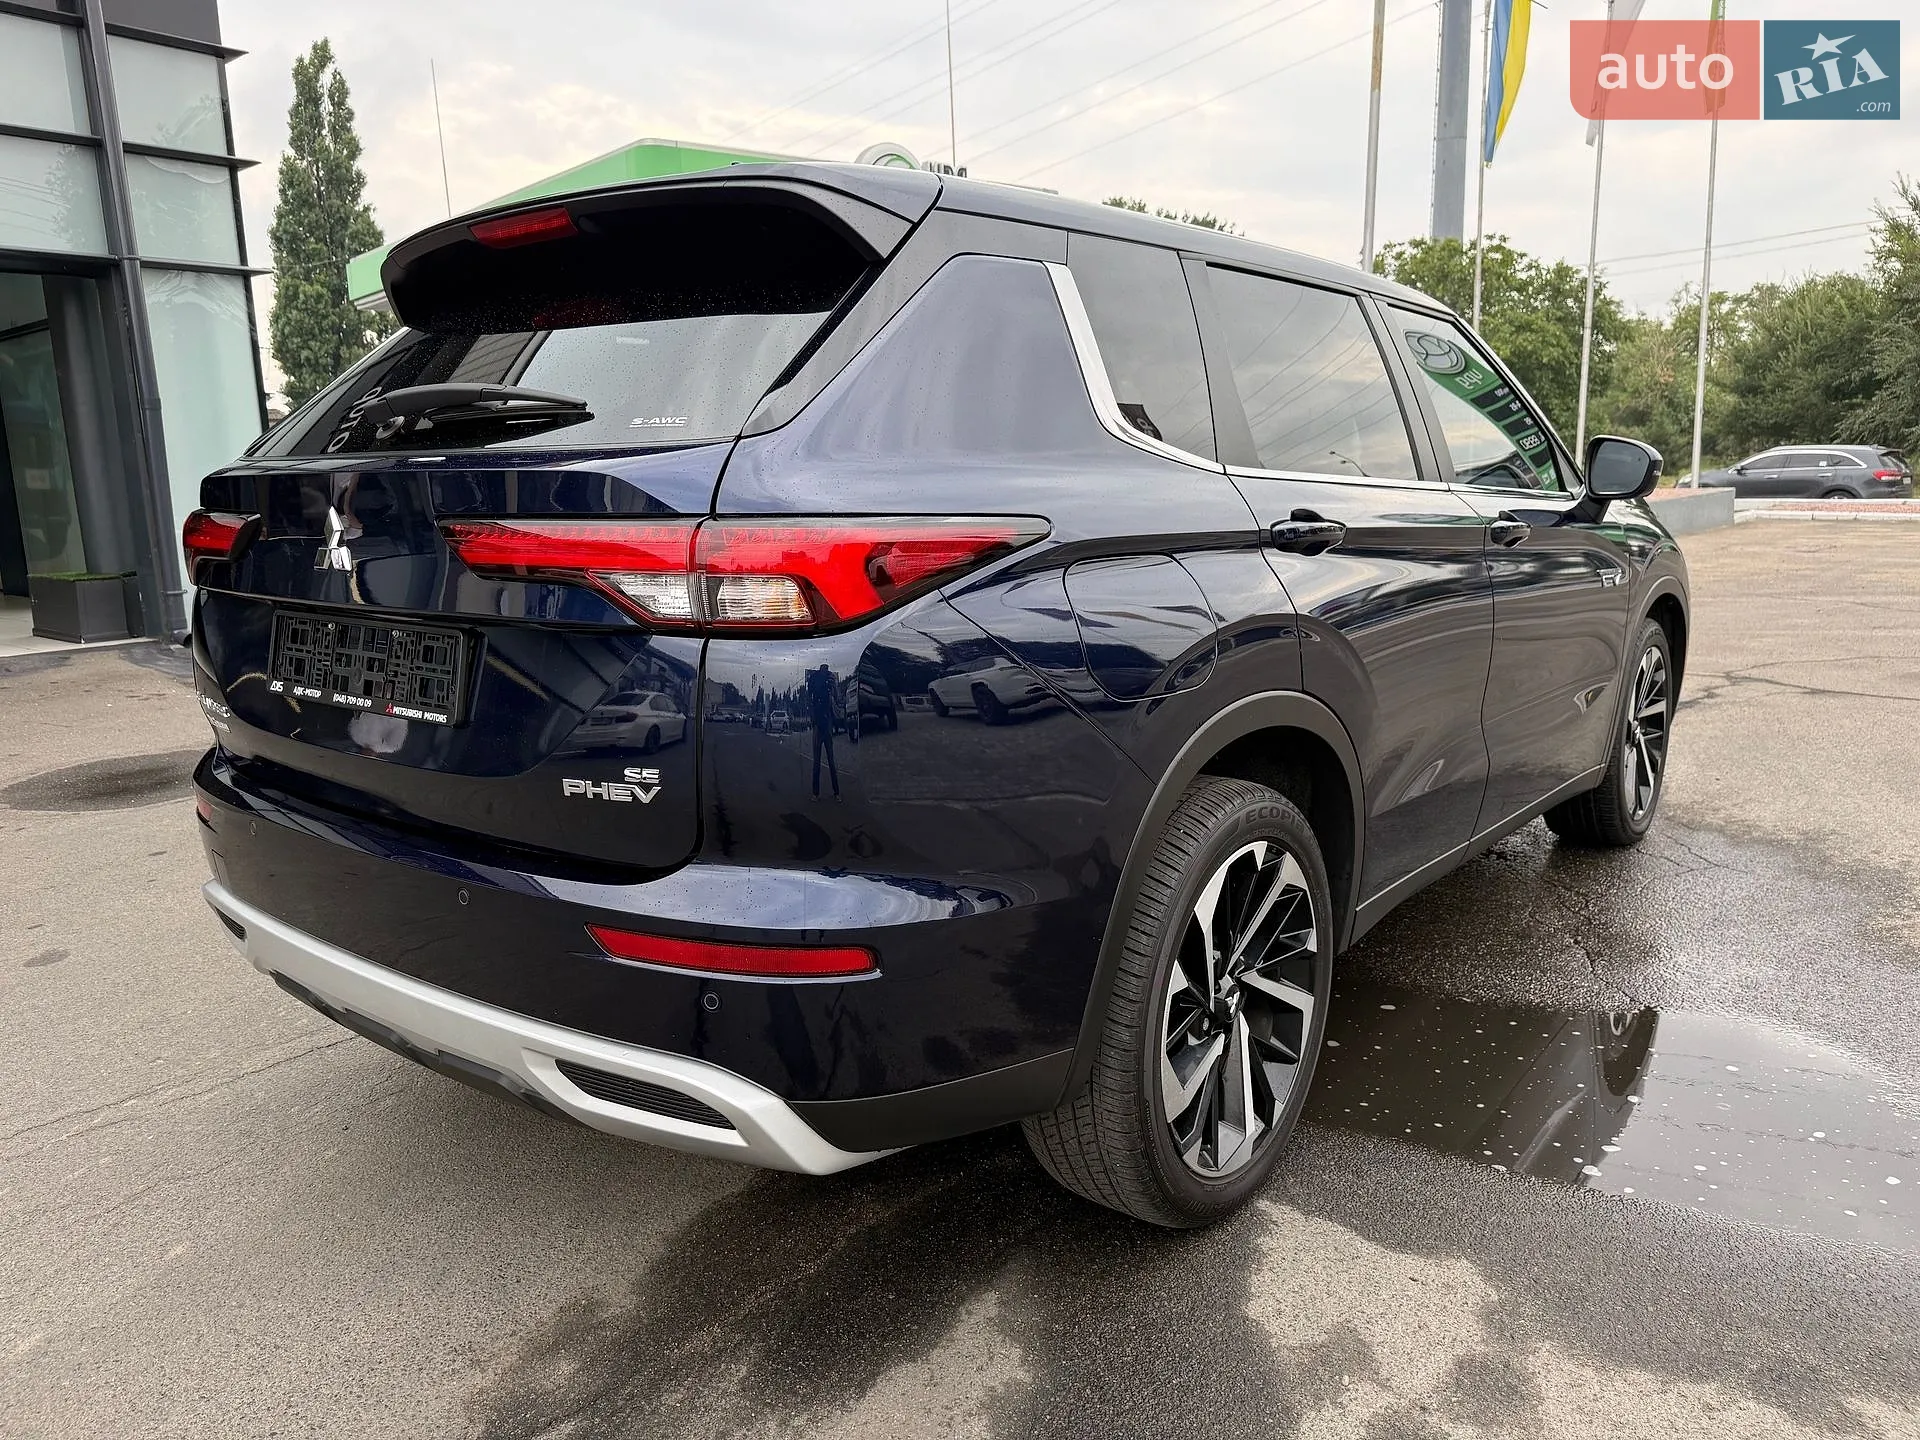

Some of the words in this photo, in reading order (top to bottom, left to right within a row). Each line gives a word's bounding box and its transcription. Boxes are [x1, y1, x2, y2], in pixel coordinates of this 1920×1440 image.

[630, 416, 688, 425] S-AWC
[346, 695, 356, 705] 709
[364, 699, 372, 708] 09
[393, 706, 423, 719] MITSUBISHI
[423, 711, 448, 723] MOTORS
[623, 767, 661, 784] SE
[562, 778, 662, 804] PHEV
